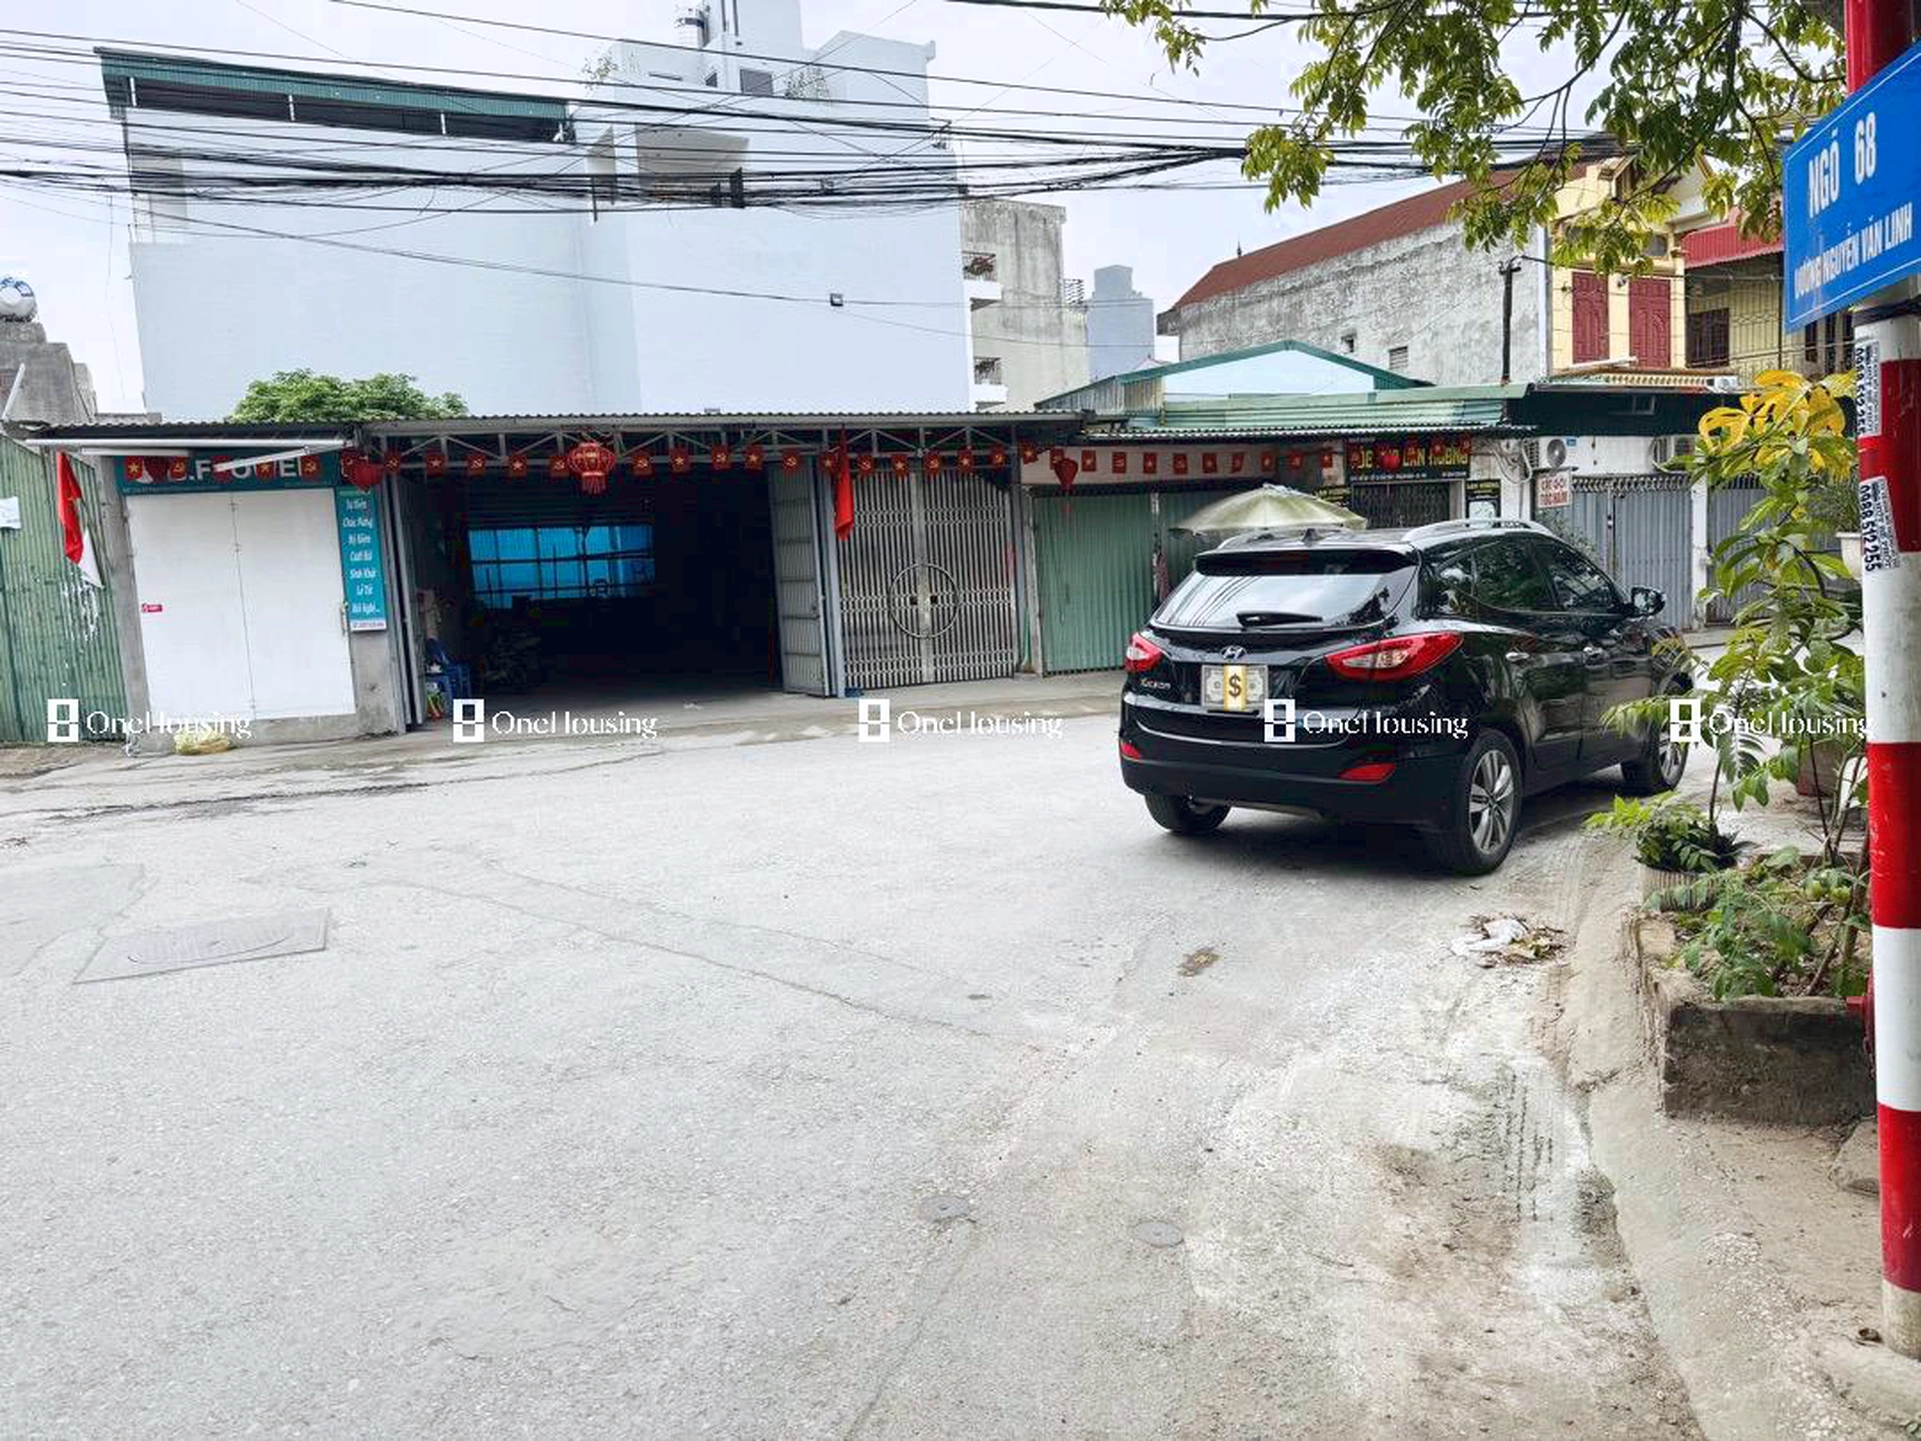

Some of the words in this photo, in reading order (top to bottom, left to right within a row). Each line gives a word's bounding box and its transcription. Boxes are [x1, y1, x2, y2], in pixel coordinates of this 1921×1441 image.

[1854, 111, 1877, 185] 68
[1861, 214, 1883, 265] VĂN
[1884, 201, 1913, 252] LINH
[1860, 485, 1873, 519] 0988
[1862, 520, 1878, 545] 512
[1863, 544, 1882, 572] 255
